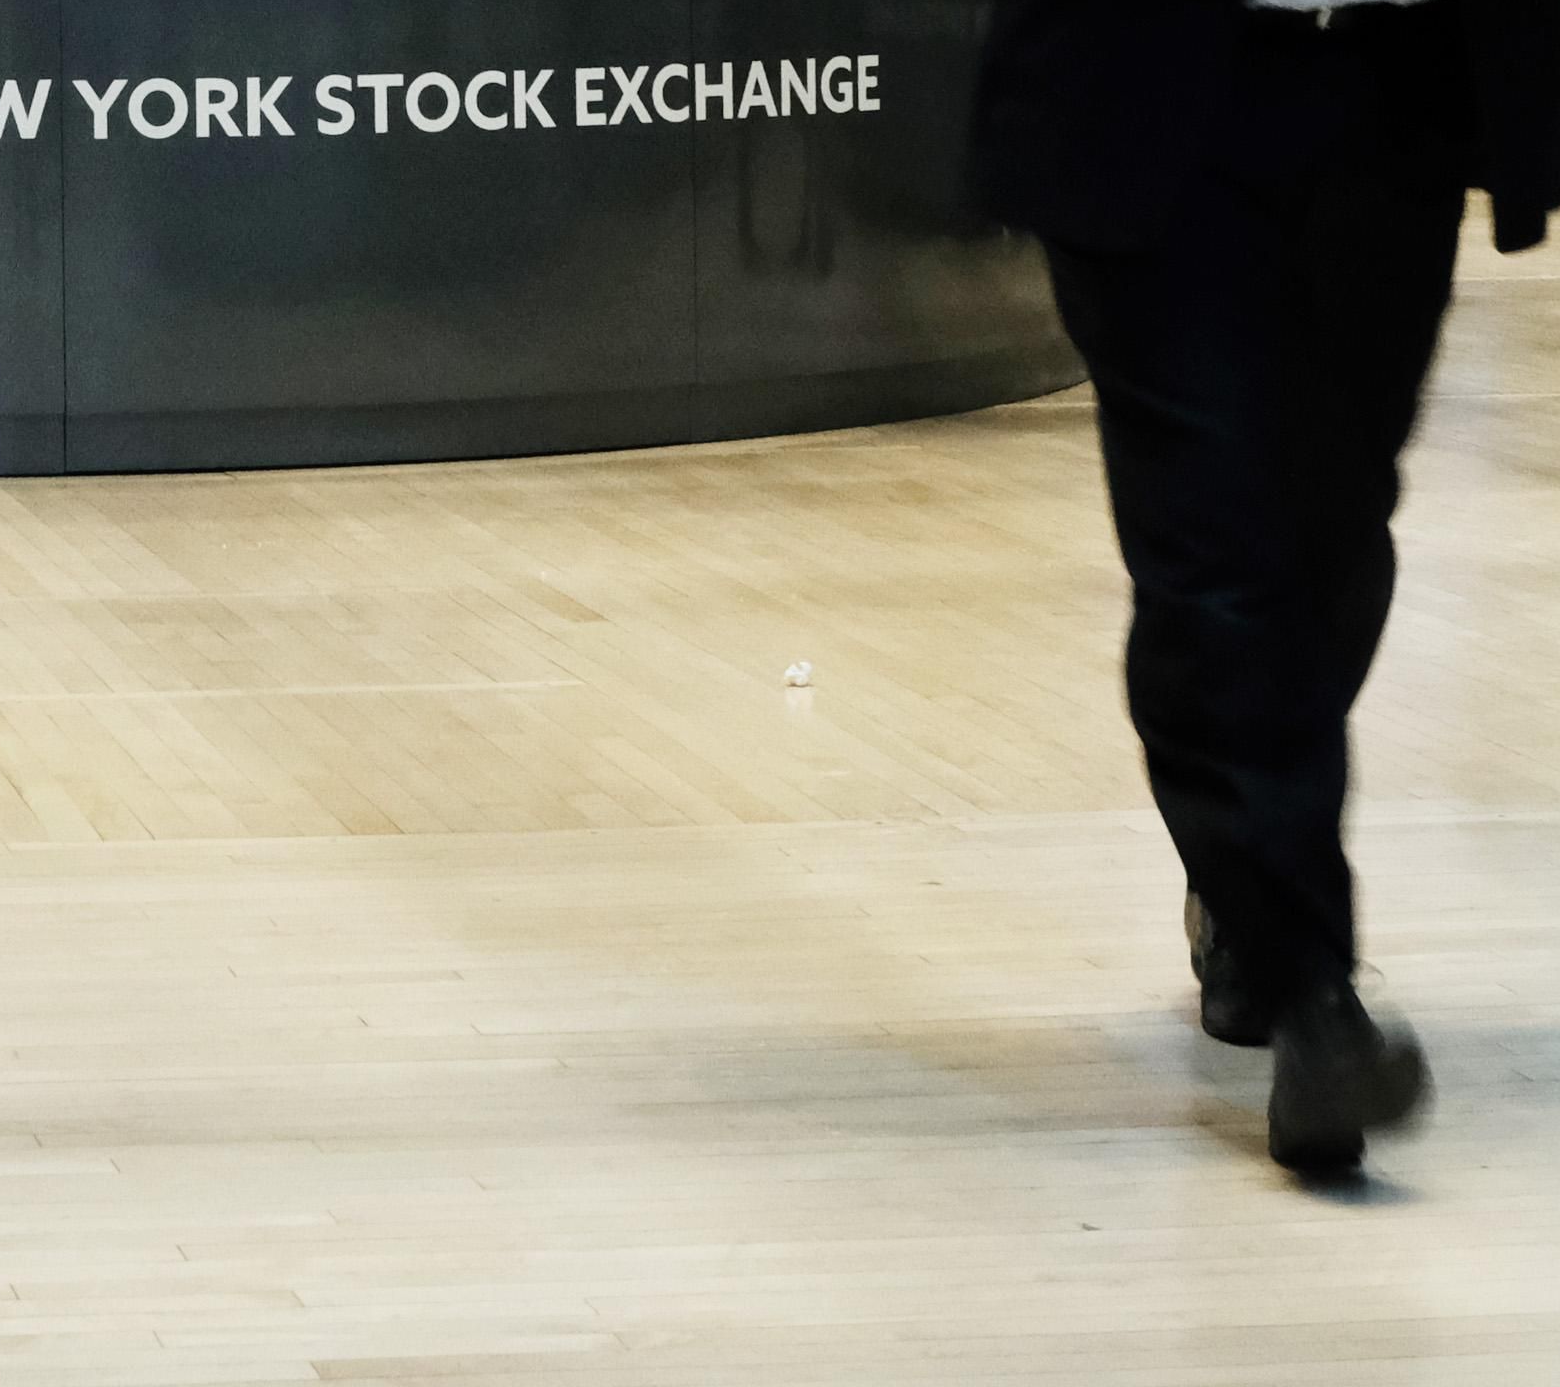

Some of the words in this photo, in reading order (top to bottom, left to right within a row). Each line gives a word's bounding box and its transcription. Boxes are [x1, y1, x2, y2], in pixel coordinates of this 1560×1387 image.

[72, 74, 297, 141] YORK
[314, 69, 557, 136] STOCK
[573, 53, 882, 129] EXCHANGE
